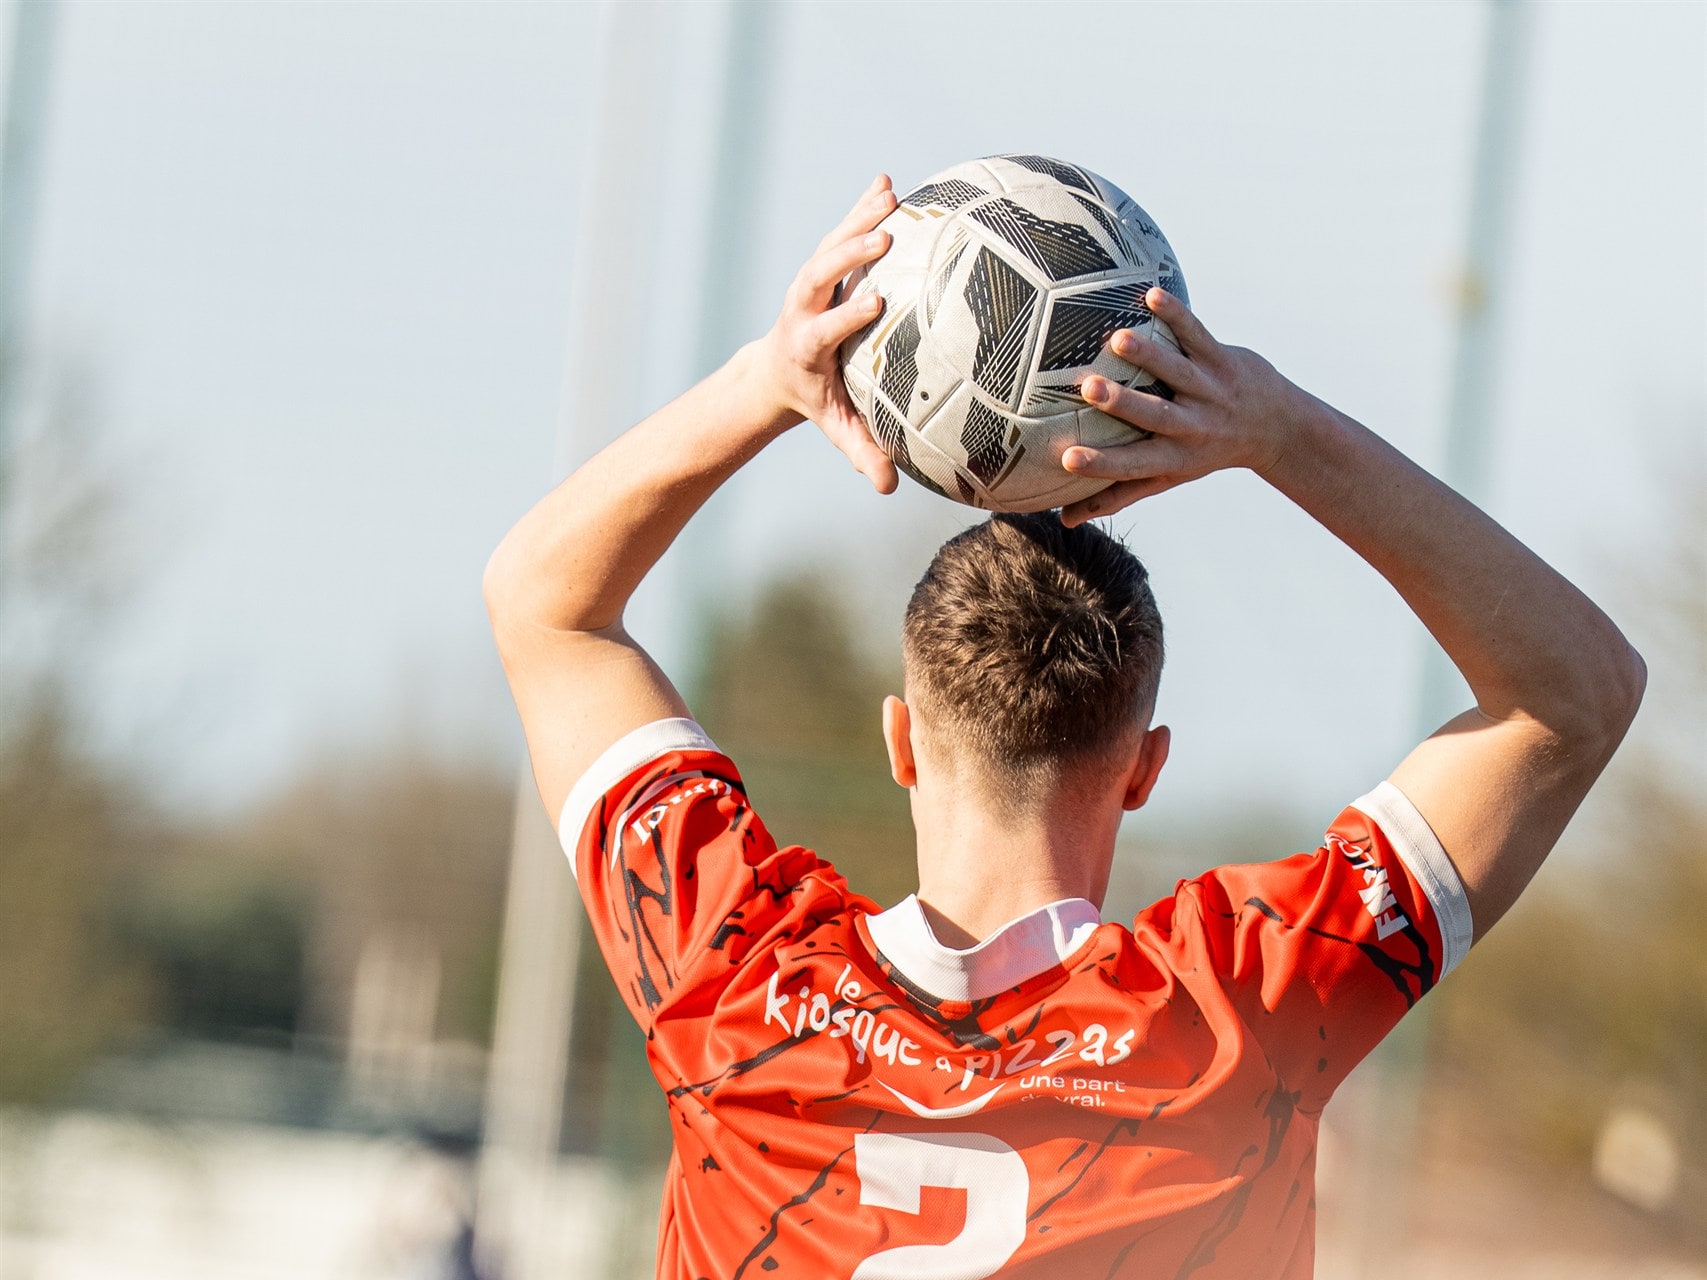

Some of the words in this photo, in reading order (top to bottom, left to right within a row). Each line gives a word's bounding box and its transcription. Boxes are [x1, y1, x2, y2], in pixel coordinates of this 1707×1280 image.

[834, 963, 861, 1005] le
[764, 971, 922, 1066] kiosque
[960, 1023, 1136, 1091] pizzas
[1019, 1075, 1065, 1089] une
[1072, 1078, 1126, 1092] part
